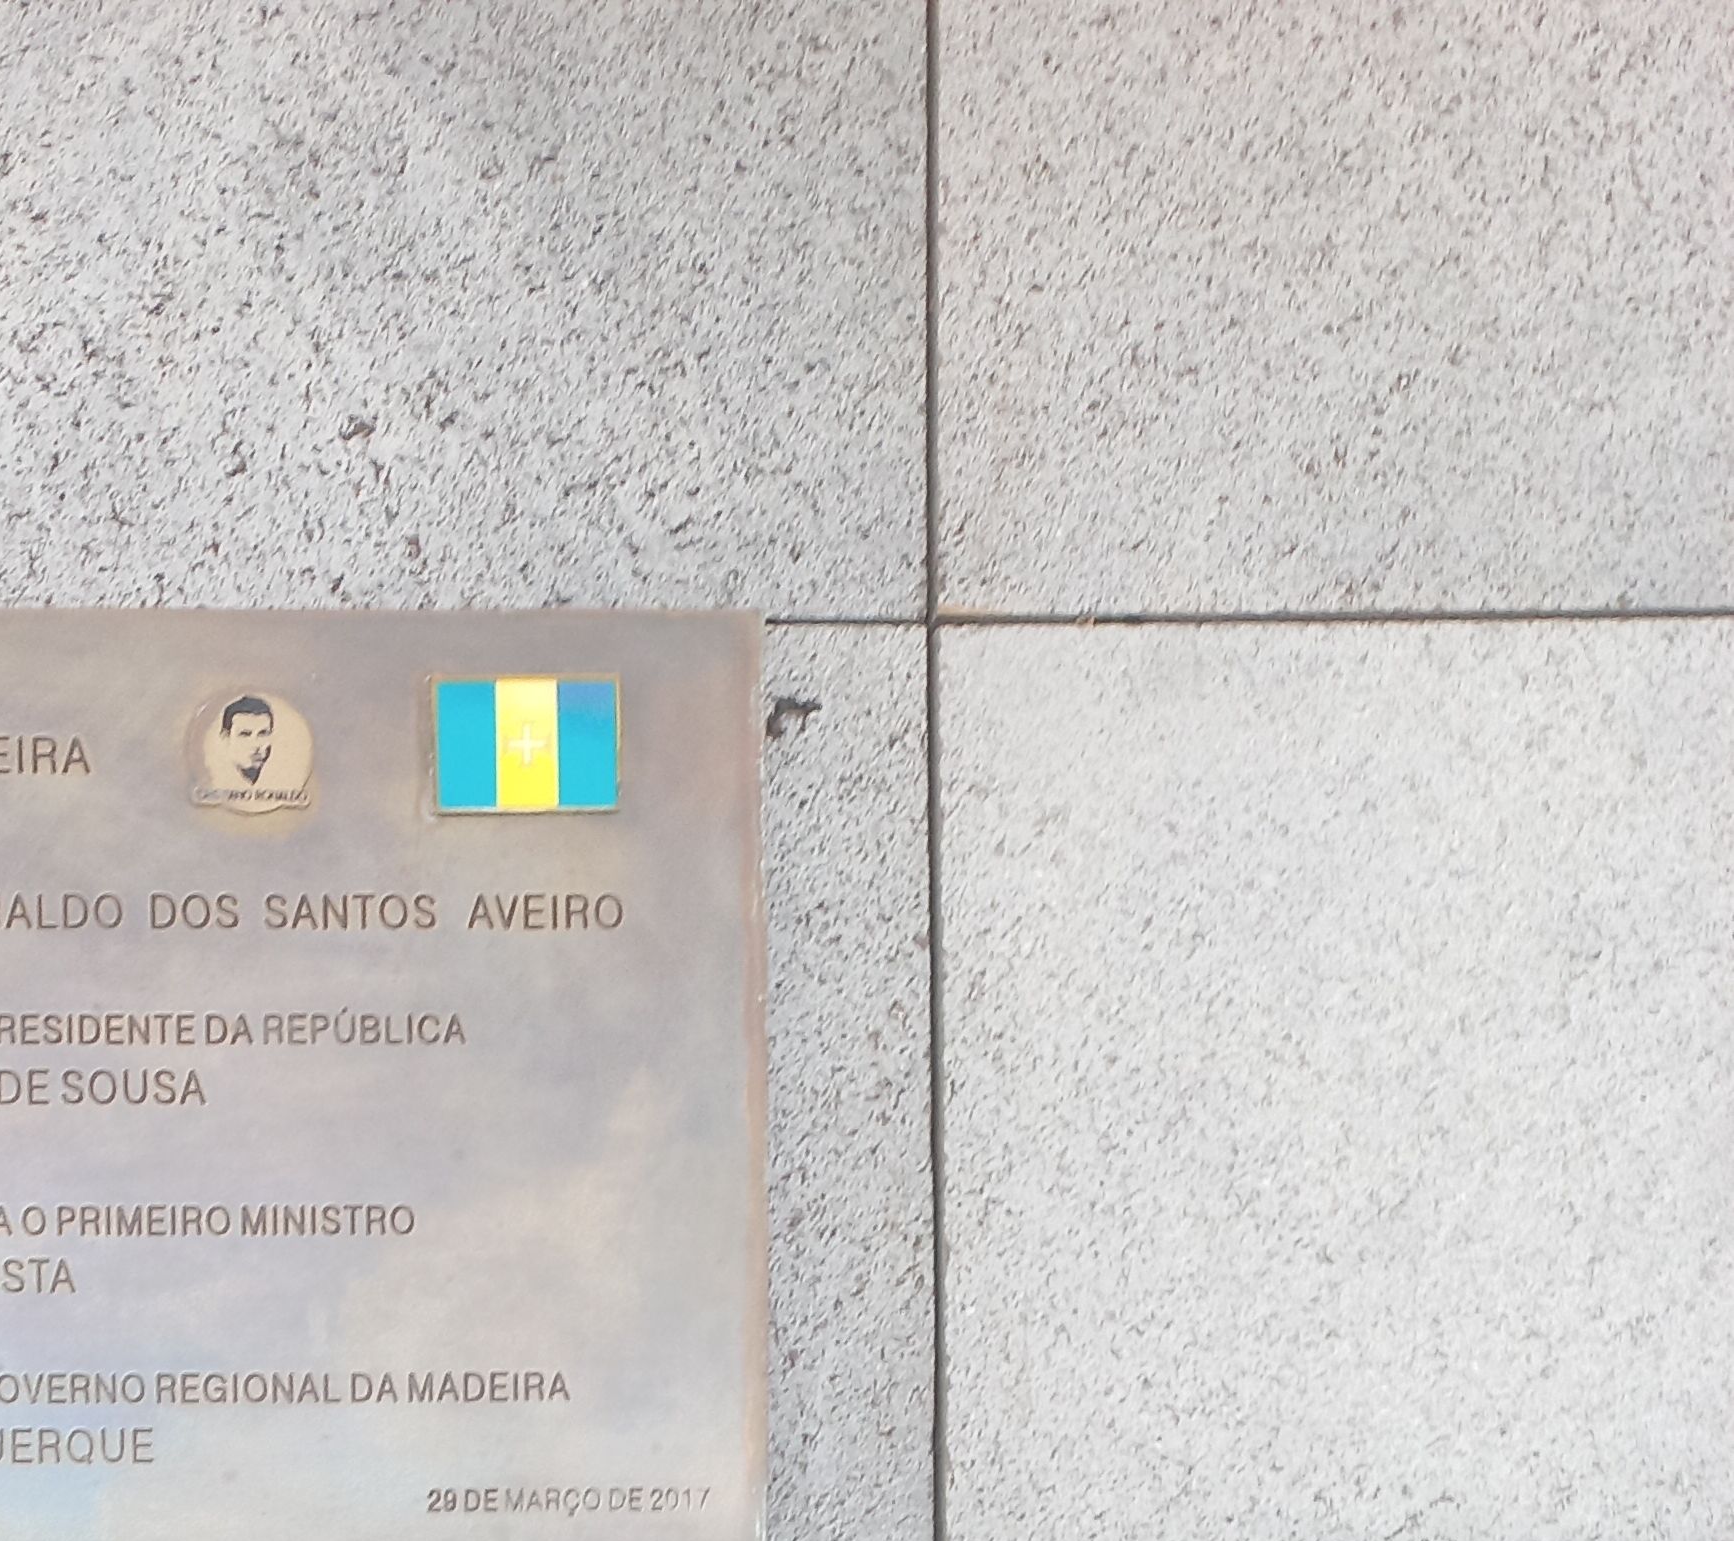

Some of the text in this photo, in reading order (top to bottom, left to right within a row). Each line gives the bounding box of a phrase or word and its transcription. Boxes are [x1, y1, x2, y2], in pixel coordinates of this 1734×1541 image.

[148, 893, 240, 931] DOS
[263, 893, 438, 932] SANTOS
[466, 894, 624, 932] AVEIRO
[203, 1014, 254, 1046] DA
[262, 1006, 466, 1046] REPÚBLICA
[61, 1069, 208, 1107] SOUSA
[21, 1205, 48, 1237] O
[56, 1205, 232, 1237] PRIMEIRO
[241, 1204, 416, 1237] MINISTRO
[154, 1371, 342, 1404] REGIONAL
[350, 1371, 398, 1404] DA
[407, 1372, 571, 1403] MADEIRA
[426, 1486, 712, 1518] 29 DE MARÇO DE 2017
